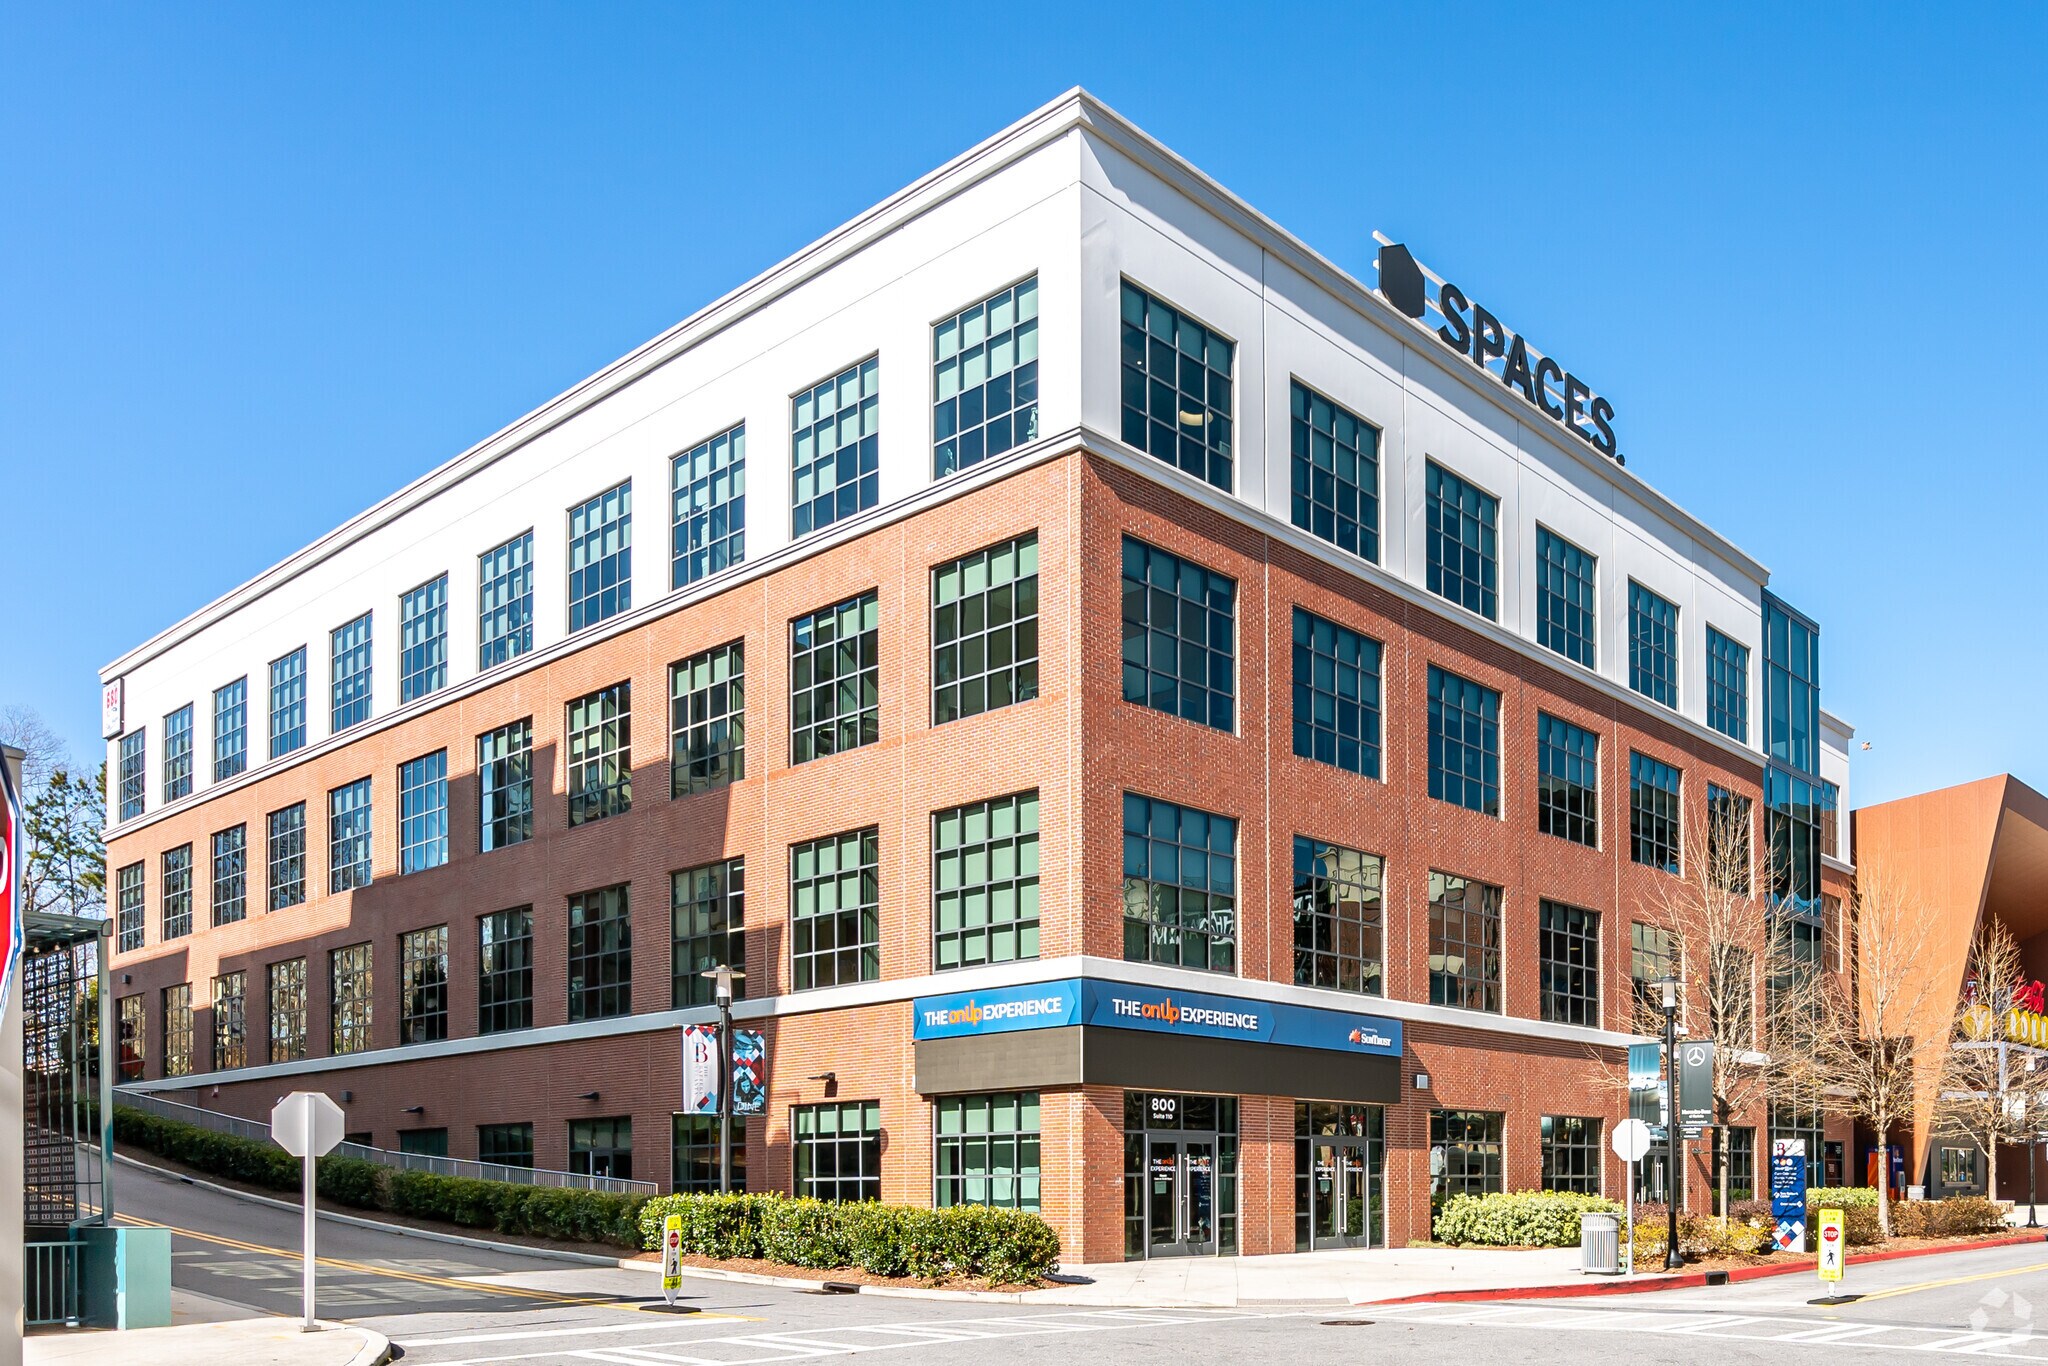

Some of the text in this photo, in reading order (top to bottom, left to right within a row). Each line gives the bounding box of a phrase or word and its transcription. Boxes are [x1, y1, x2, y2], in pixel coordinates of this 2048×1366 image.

[924, 1009, 949, 1027] THE
[982, 996, 1062, 1020] EXPERIENCE
[1112, 998, 1141, 1017] THE
[1180, 1006, 1258, 1030] EXPERIENCE
[1151, 1097, 1175, 1112] 800
[1823, 1230, 1839, 1239] STOP
